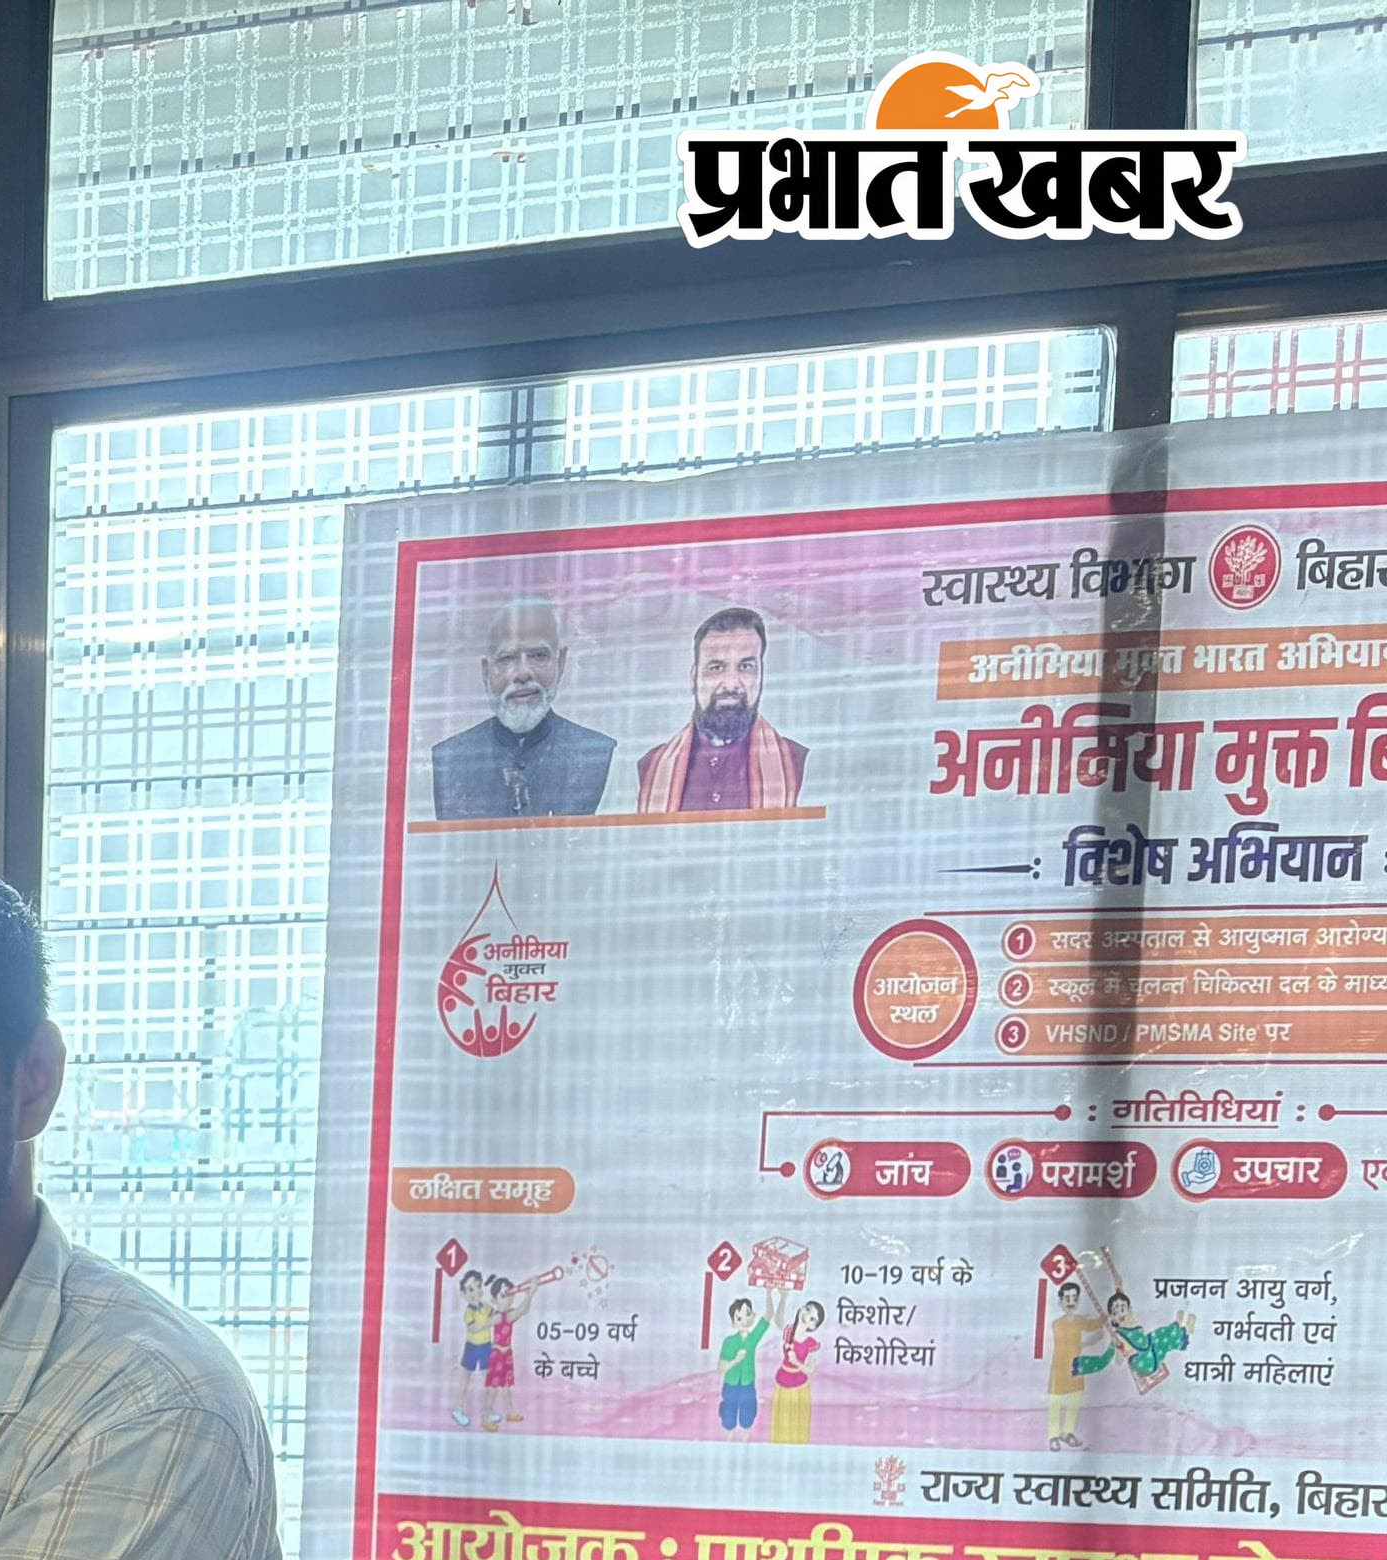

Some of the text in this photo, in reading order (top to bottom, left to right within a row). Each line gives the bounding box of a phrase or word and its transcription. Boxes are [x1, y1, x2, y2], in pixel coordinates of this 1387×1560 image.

[923, 562, 1059, 606] स्वास्थ्य
[1070, 547, 1197, 600] विभाग
[968, 643, 1103, 684] अनीमिया
[1193, 642, 1268, 674] भारत
[929, 703, 1204, 798] अनीमिया
[1213, 717, 1337, 816] मुक्त
[1062, 823, 1178, 886] विशेष
[1188, 821, 1368, 884] अभियान
[483, 934, 570, 962] अनीमिया
[1050, 931, 1094, 950] सदर
[1193, 922, 1212, 948] से
[486, 973, 559, 1004] बिहार
[873, 973, 959, 997] आयोजन
[1279, 975, 1312, 995] दल
[1317, 966, 1339, 993] के
[889, 1004, 940, 1025] स्थल
[1045, 1024, 1118, 1044] VHSND
[1135, 1023, 1213, 1043] PMSMA
[1219, 1022, 1257, 1042] Site
[1265, 1022, 1294, 1042] पर
[1112, 1089, 1283, 1124] गतिविधियां
[875, 1152, 934, 1189] जांच
[1041, 1154, 1138, 1190] परामर्श
[1233, 1155, 1323, 1185] उपचार
[409, 1176, 556, 1206] लक्षित समूह
[910, 1256, 945, 1287] वर्ष
[950, 1257, 974, 1286] के
[1153, 1278, 1226, 1300] प्रजनन
[1236, 1277, 1285, 1309] आयु
[836, 1298, 917, 1327] किशोर/
[606, 1313, 638, 1344] वर्ष
[1213, 1313, 1336, 1345] गर्भवती एवं
[533, 1355, 600, 1381] के बच्चे
[834, 1338, 936, 1367] किशोरियां
[1183, 1356, 1335, 1387] धात्री महिलाएं
[920, 1470, 1004, 1505] राज्य
[1012, 1473, 1142, 1509] स्वास्थ्य
[1151, 1467, 1281, 1519] समिति,
